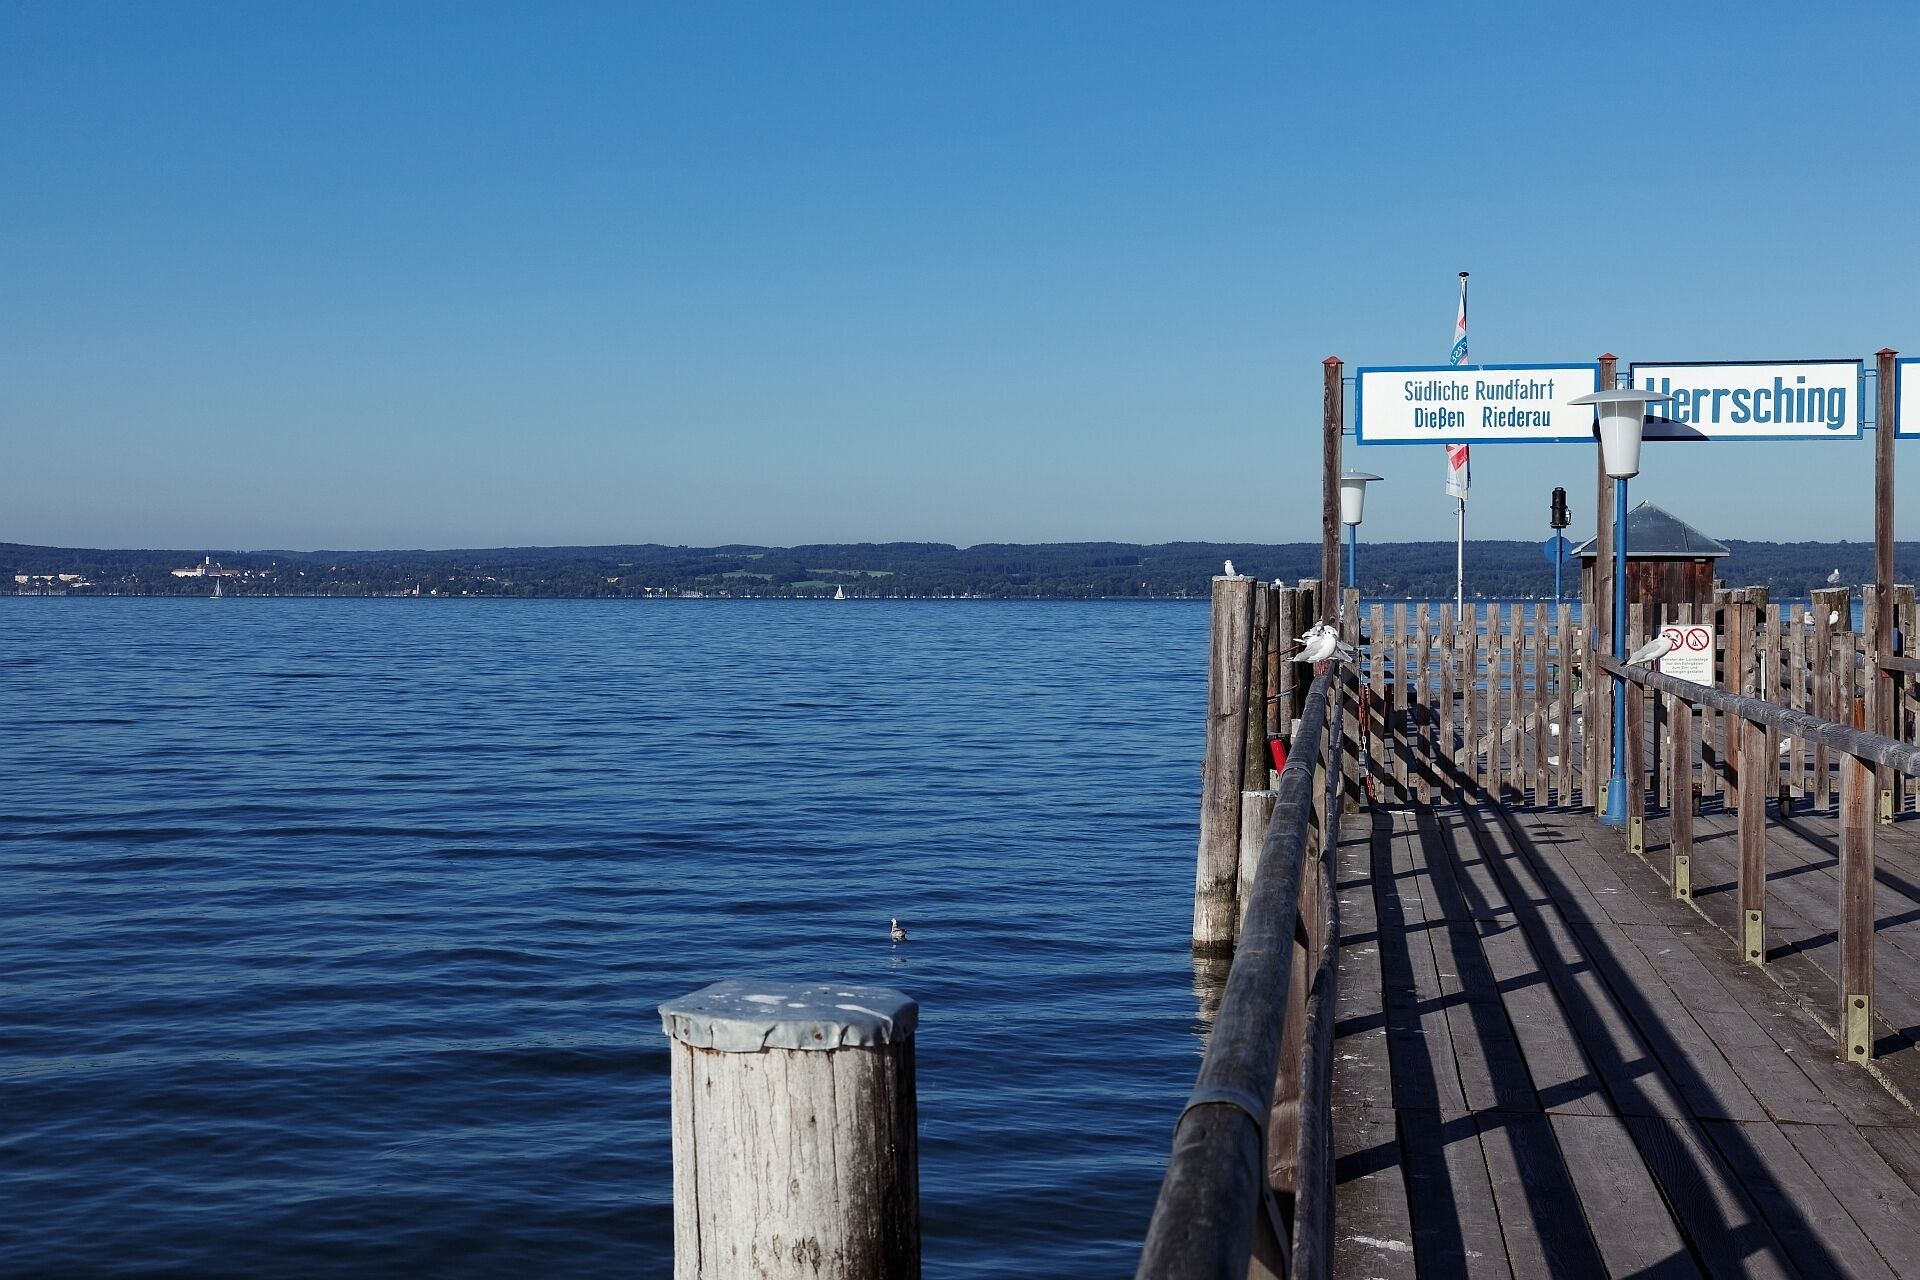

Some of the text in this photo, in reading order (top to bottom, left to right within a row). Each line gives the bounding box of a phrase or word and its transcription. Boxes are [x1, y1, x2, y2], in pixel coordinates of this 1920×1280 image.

[1404, 378, 1555, 402] Südliche Rundfahrt
[1645, 375, 1847, 430] Herrsching
[1414, 406, 1551, 430] Dießen Riederau
